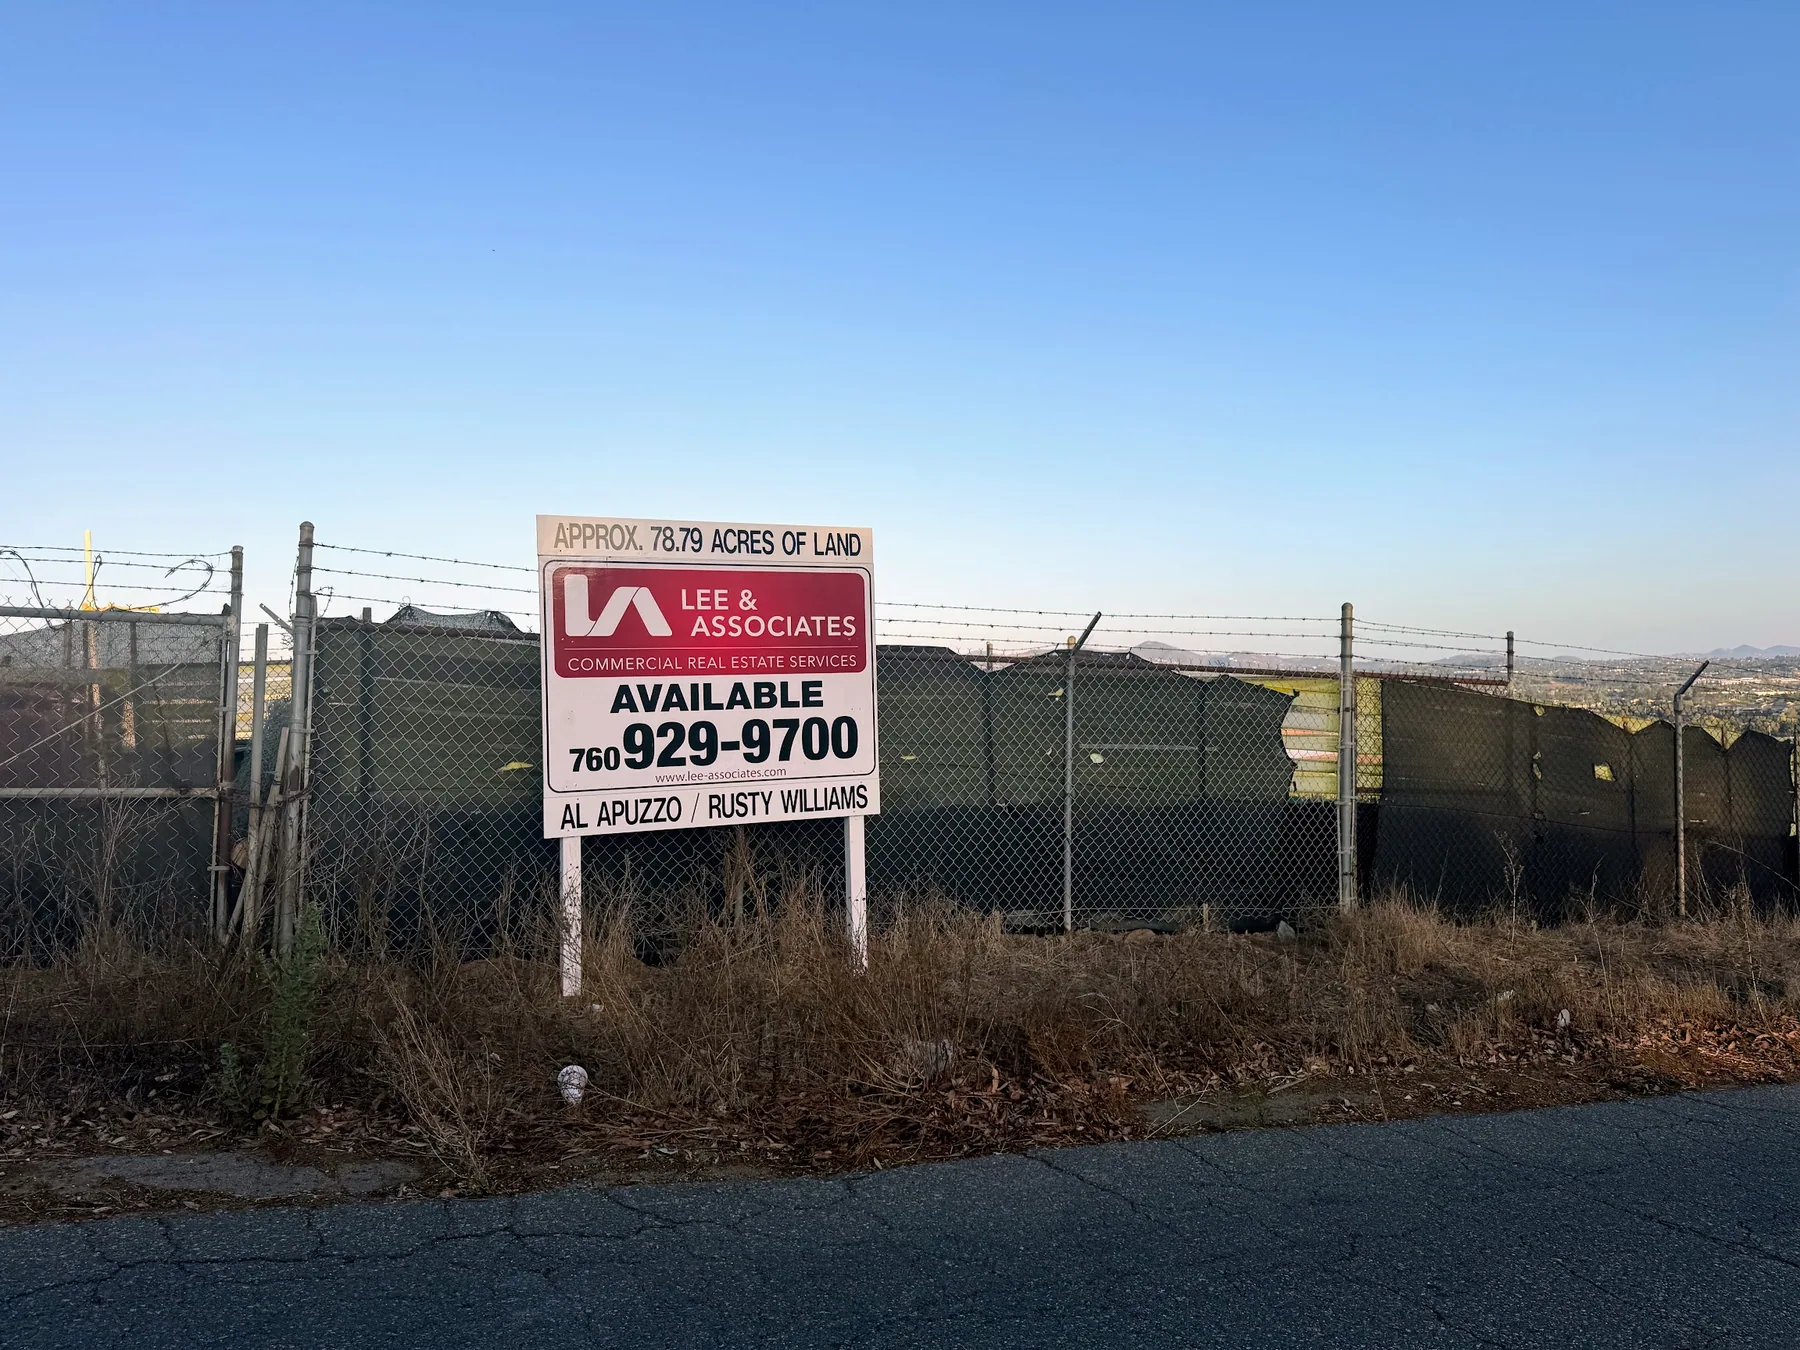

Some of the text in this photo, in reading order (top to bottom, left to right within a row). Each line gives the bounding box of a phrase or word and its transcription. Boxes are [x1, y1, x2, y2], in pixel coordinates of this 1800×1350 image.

[553, 522, 861, 557] APPROX. 78.79 ACRES OF LAND
[681, 588, 758, 611] LEE &
[690, 615, 856, 637] ASSOCIATES
[568, 654, 857, 671] COMMERCIAL REAL ESTATE SERVICES
[610, 681, 824, 714] AVAILABLE
[569, 715, 859, 772] 760 929-9700
[655, 767, 787, 783] www.lee-associates.com
[560, 803, 588, 830] AL
[597, 796, 682, 827] APUZZO
[708, 790, 773, 819] RUSTY
[781, 784, 869, 814] WILLIAMS
